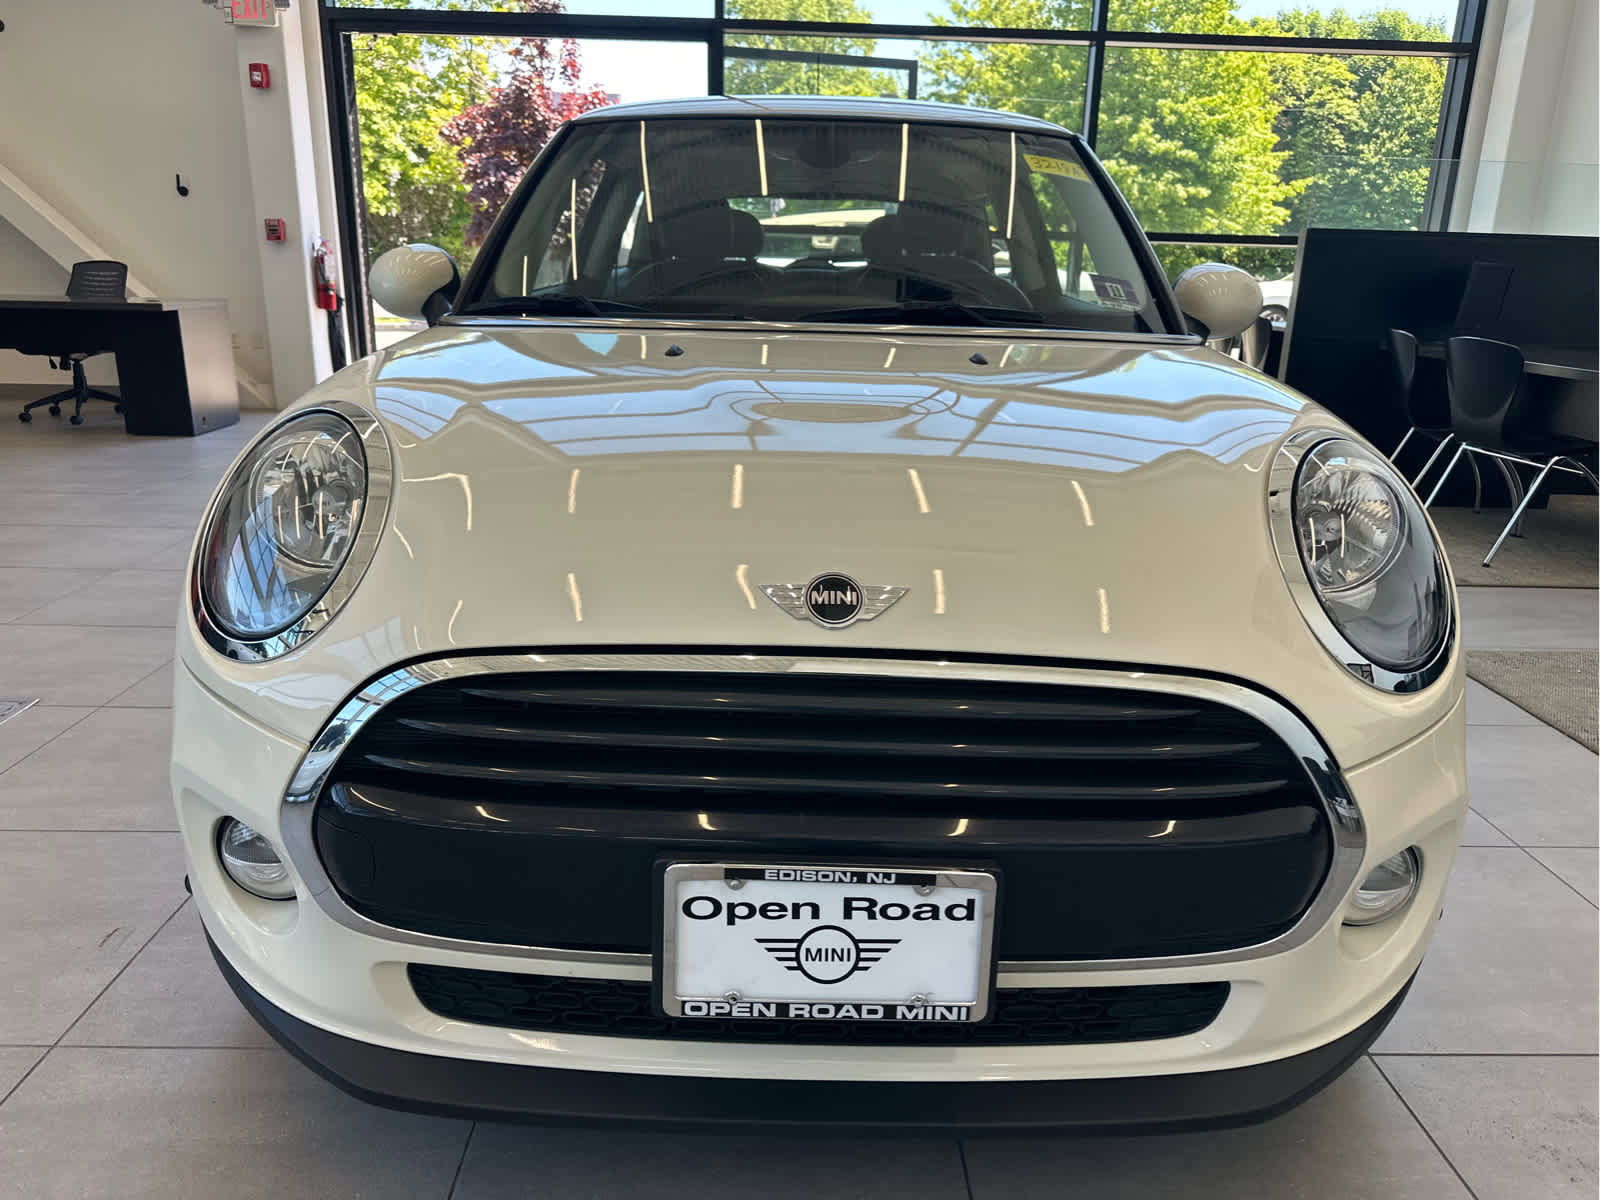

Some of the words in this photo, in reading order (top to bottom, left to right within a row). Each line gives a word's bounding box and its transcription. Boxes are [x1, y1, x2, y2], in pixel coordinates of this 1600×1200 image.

[811, 590, 857, 605] MINI
[764, 869, 857, 883] EDISON,
[866, 873, 896, 884] NJ
[681, 896, 820, 926] Open
[843, 897, 976, 921] Road
[804, 947, 851, 962] MINI
[684, 1001, 776, 1018] OPEN
[788, 1003, 884, 1019] ROAD
[896, 1005, 967, 1021] MINI
